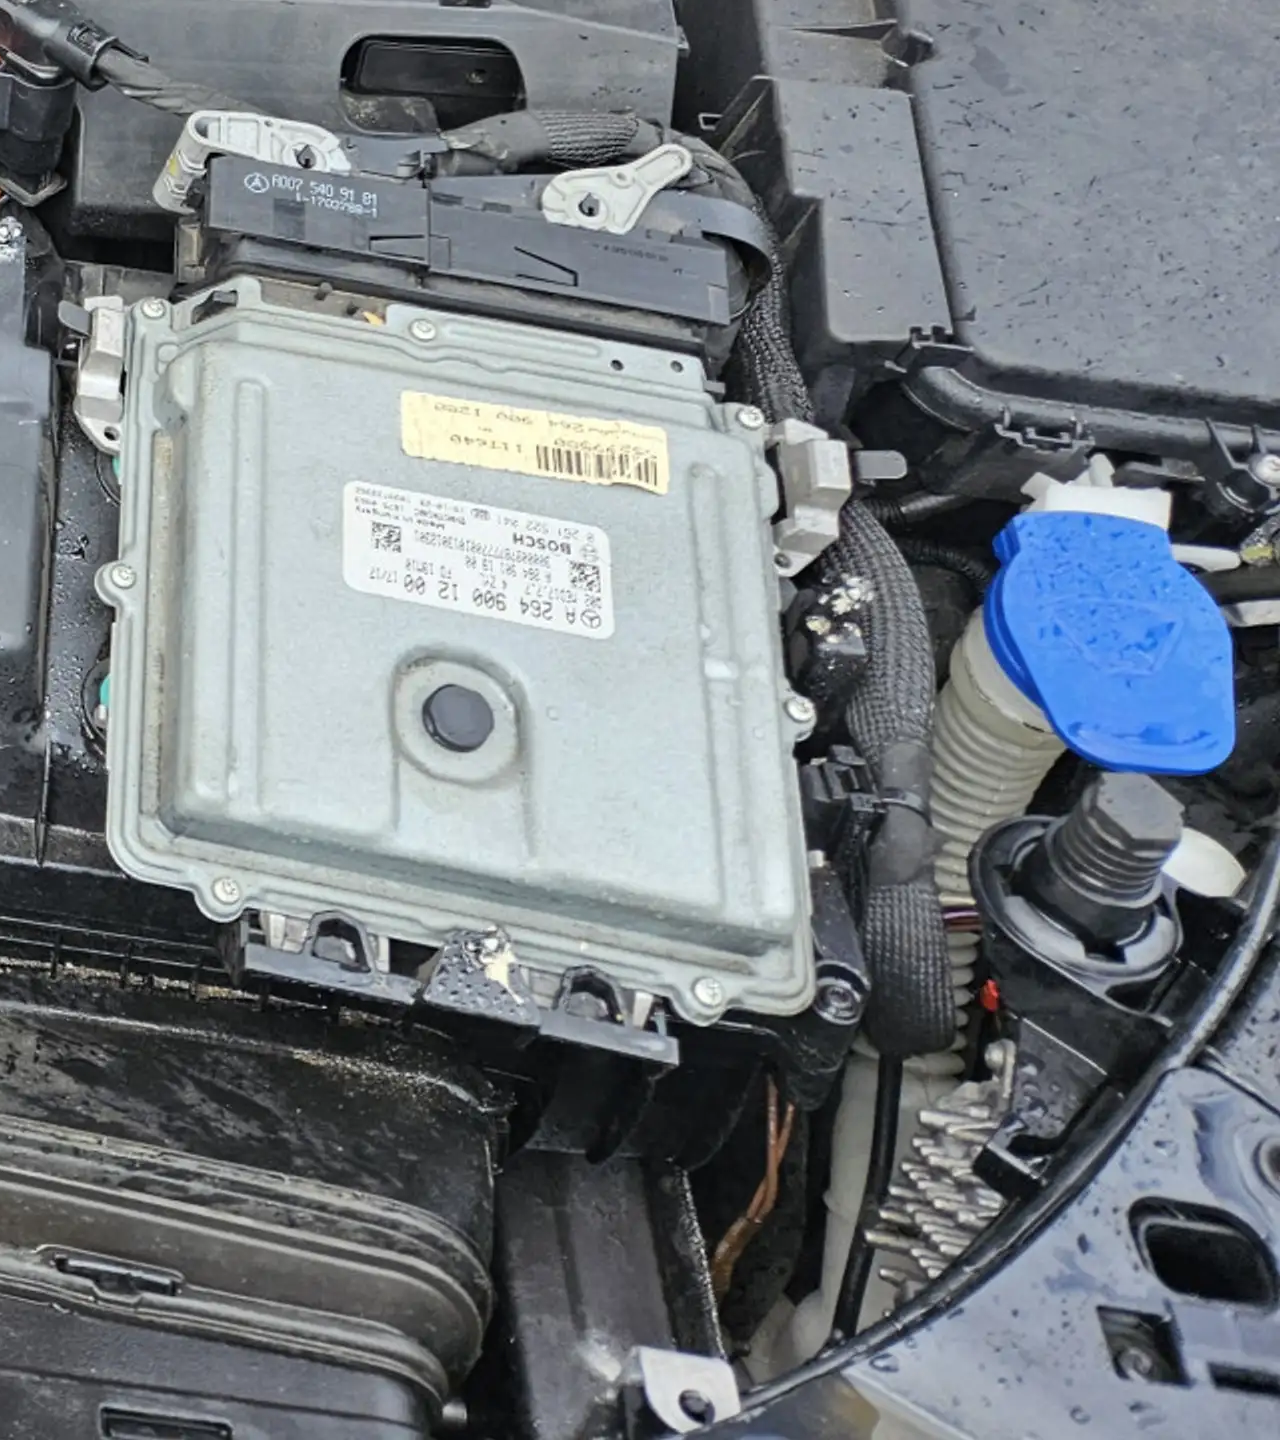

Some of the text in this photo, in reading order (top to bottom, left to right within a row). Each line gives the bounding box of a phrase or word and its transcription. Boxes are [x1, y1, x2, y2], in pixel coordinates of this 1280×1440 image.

[512, 533, 571, 556] BOSCH
[403, 574, 425, 595] 00
[438, 581, 458, 602] 12
[472, 588, 507, 612] 900
[519, 597, 553, 621] 264
[566, 609, 577, 624] A
